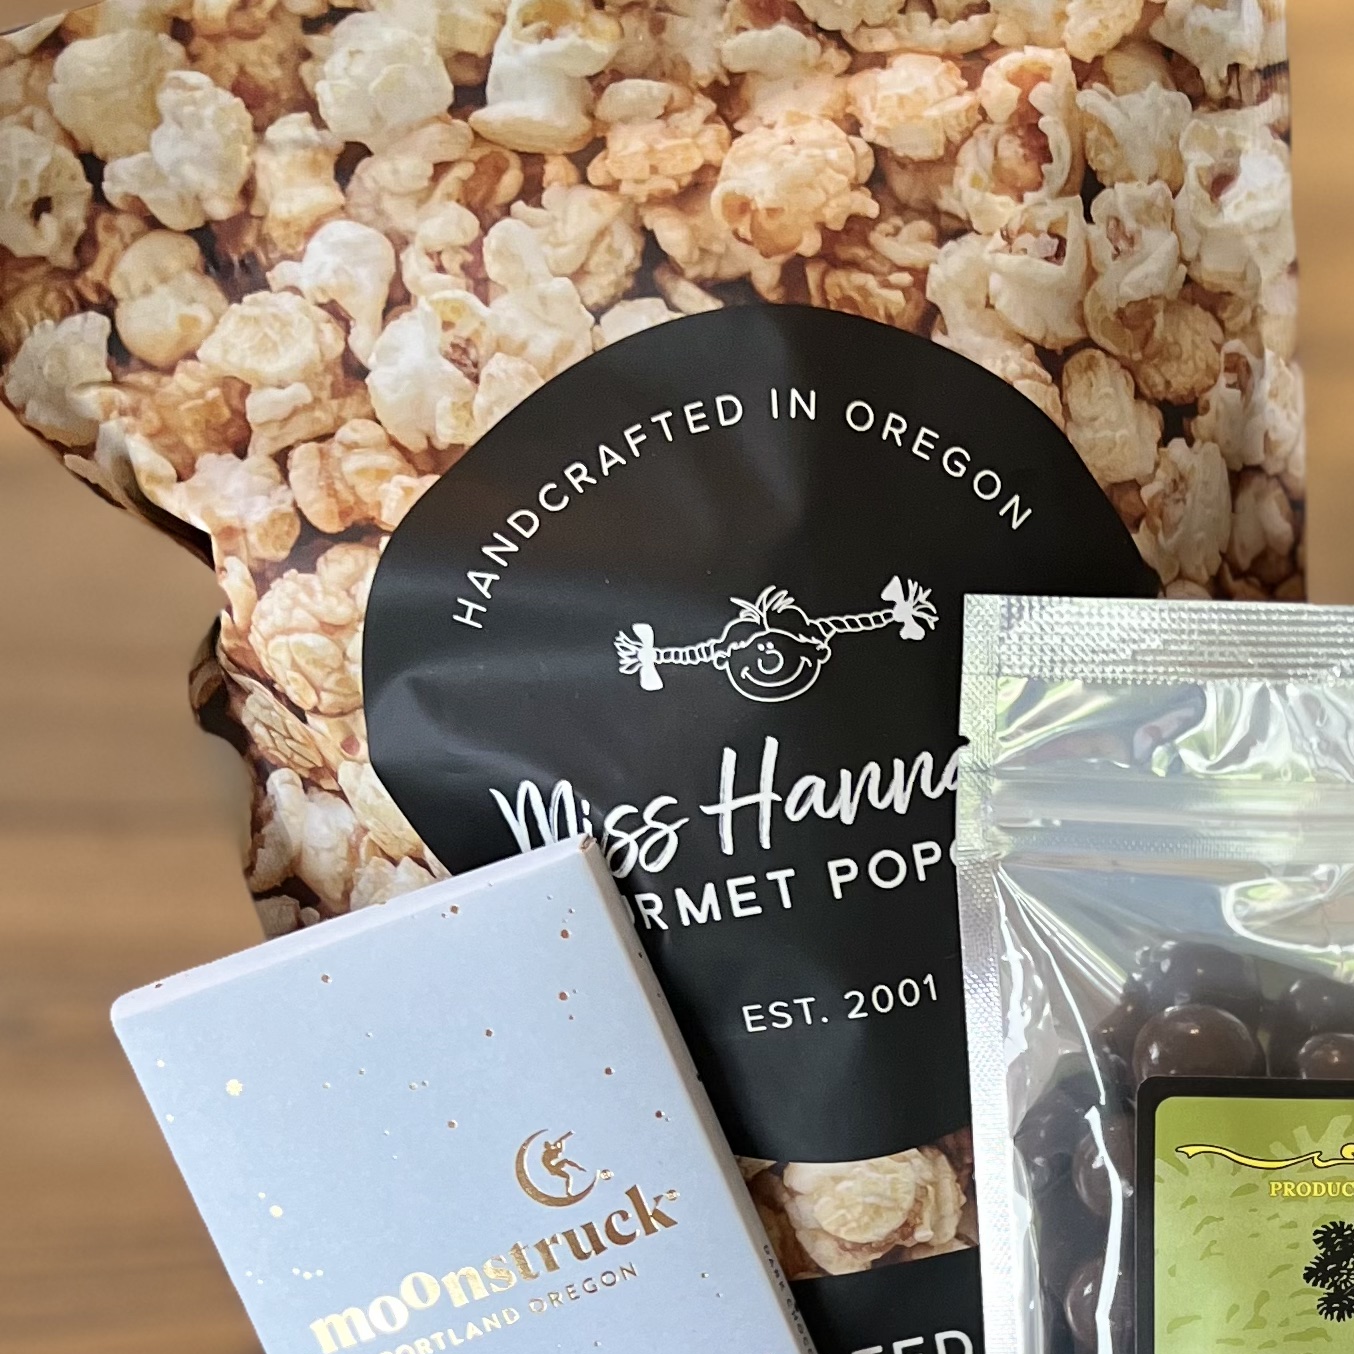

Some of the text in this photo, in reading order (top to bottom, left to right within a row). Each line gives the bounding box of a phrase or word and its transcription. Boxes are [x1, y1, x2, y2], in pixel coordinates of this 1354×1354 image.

[453, 388, 1034, 629] HANDCRAFTED IN OREGON
[489, 779, 690, 878] Miss
[620, 839, 958, 930] RMET POP
[741, 973, 937, 1032] EST. 2001
[529, 1261, 638, 1314] OREGON
